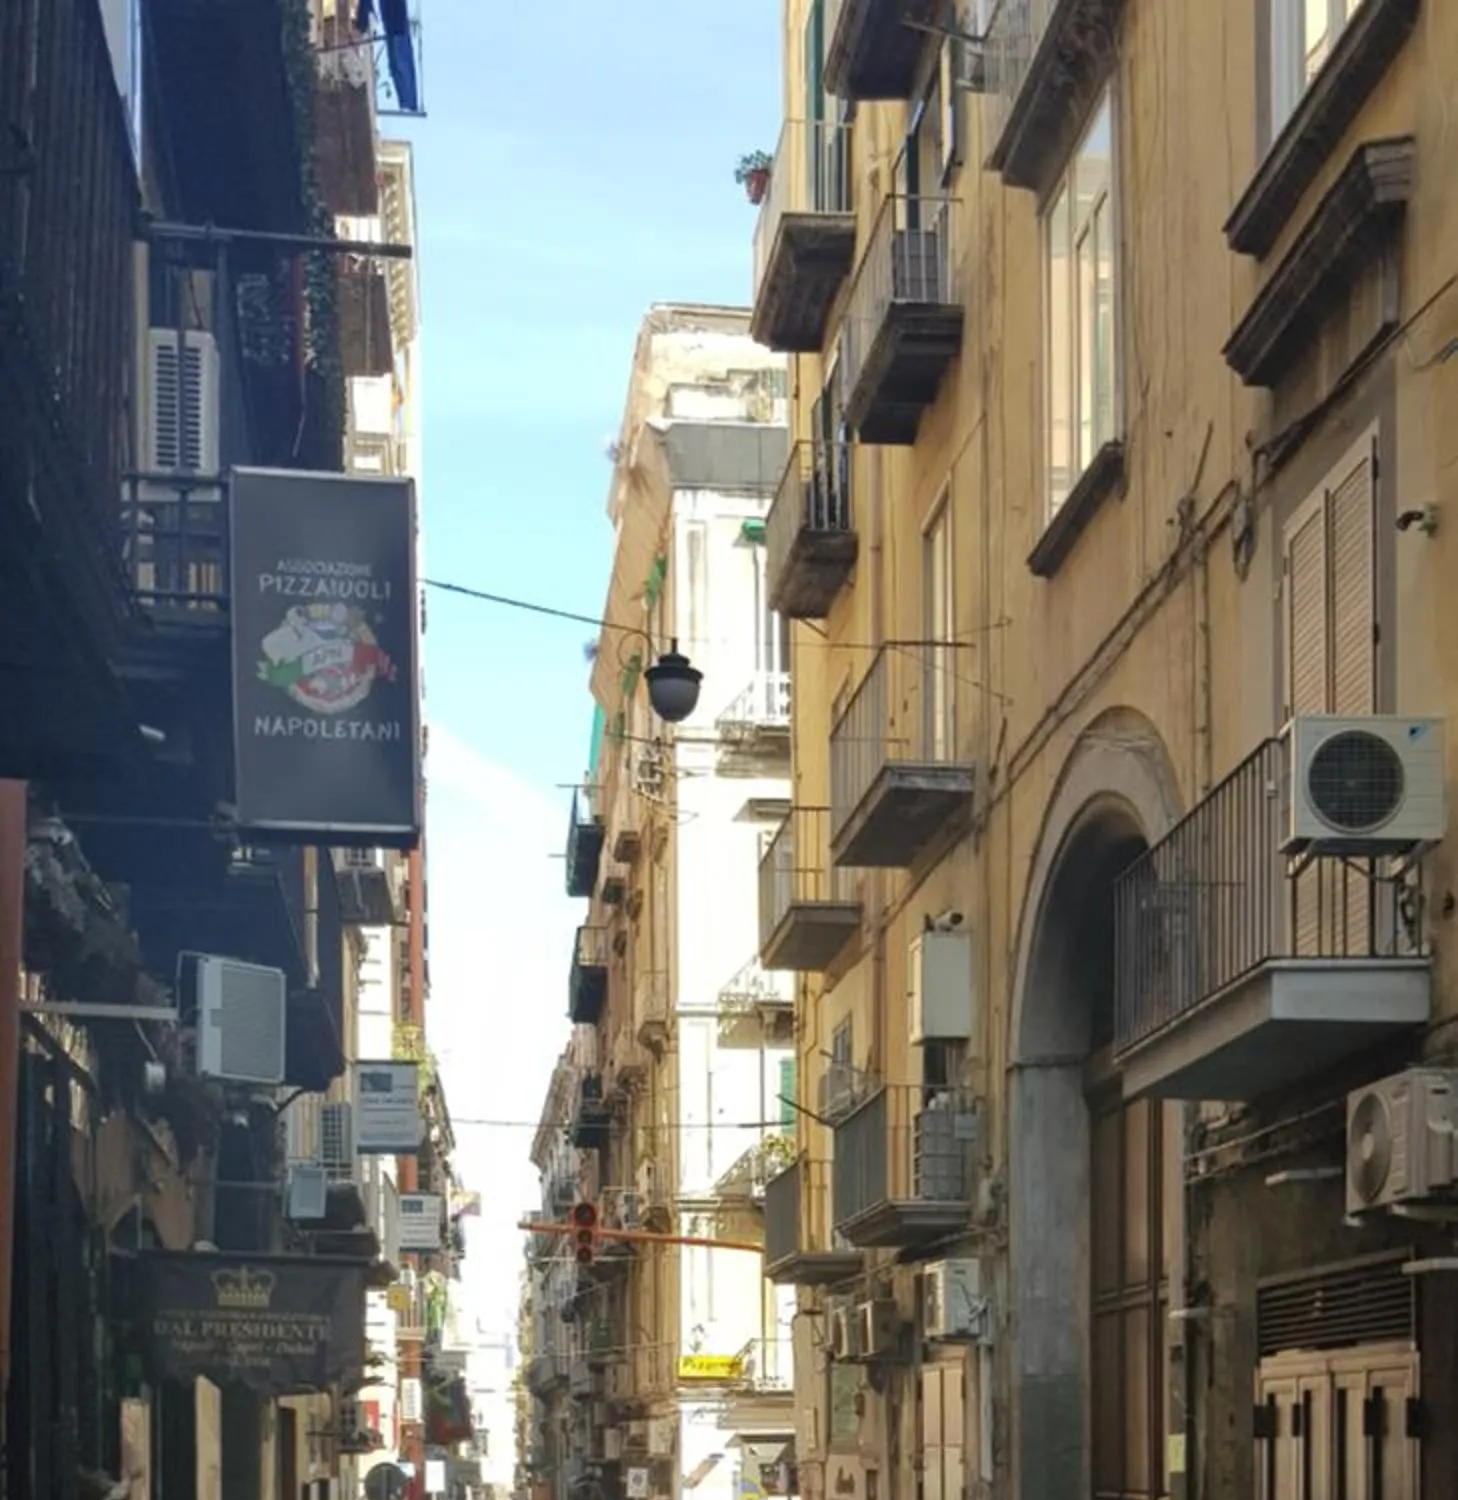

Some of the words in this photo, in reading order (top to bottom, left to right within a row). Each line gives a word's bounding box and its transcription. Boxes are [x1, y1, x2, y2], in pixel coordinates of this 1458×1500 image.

[259, 573, 391, 600] PIZZAIUOLI
[254, 715, 400, 741] NAPOLETANI
[154, 1319, 197, 1336] DAL
[201, 1320, 331, 1341] PRESIDENTE
